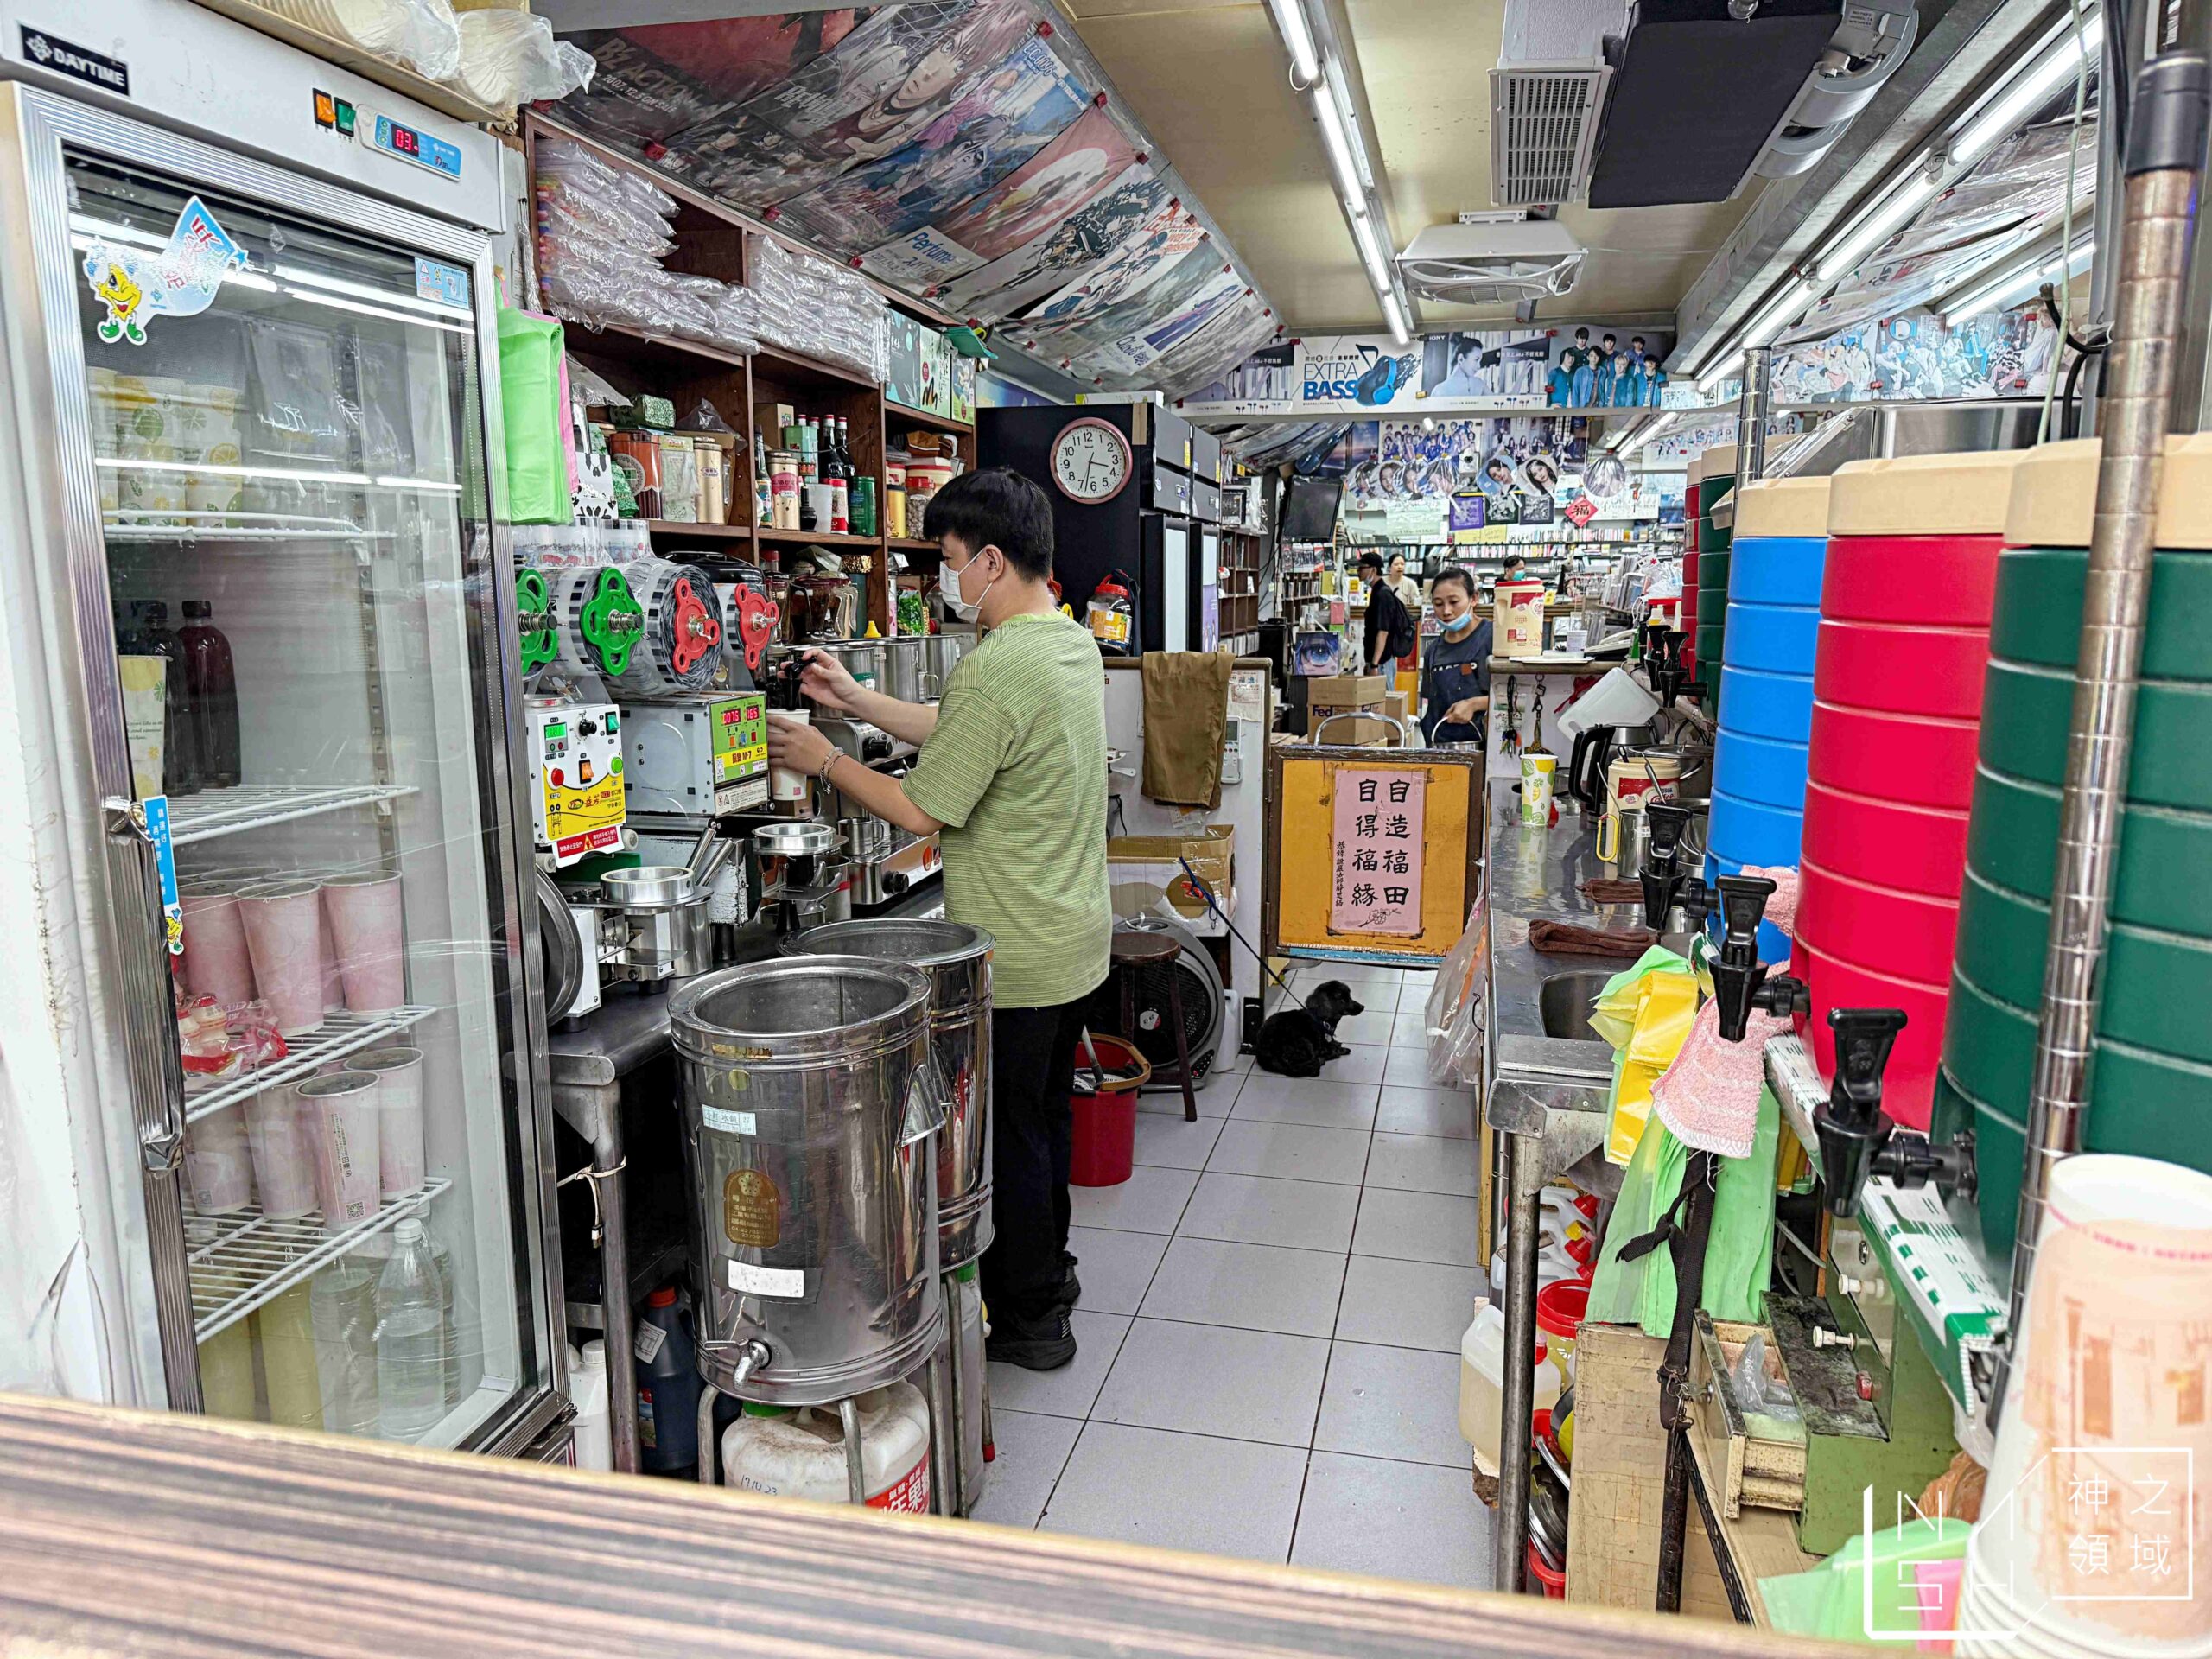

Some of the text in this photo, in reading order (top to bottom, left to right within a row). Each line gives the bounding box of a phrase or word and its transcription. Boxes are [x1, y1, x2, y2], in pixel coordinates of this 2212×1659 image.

[53, 47, 126, 86] DAYTIME
[396, 129, 413, 152] 03
[906, 232, 957, 265] Perfume
[1303, 361, 1358, 381] EXTRA
[1303, 379, 1359, 401] BASS
[1072, 435, 1081, 446] 11
[1084, 432, 1093, 442] 12
[1099, 434, 1103, 443] 1
[1065, 447, 1075, 456] 10
[1107, 442, 1114, 452] 2
[1063, 460, 1071, 469] 9
[1112, 455, 1119, 465] 3
[1068, 472, 1076, 481] 8
[1109, 467, 1116, 477] 4
[1077, 480, 1084, 489] 7
[1090, 482, 1097, 491] 6
[1102, 478, 1109, 486] 5
[1571, 504, 1590, 516] 福
[1351, 778, 1380, 908] 自得福緣
[1382, 778, 1412, 907] 自造福田
